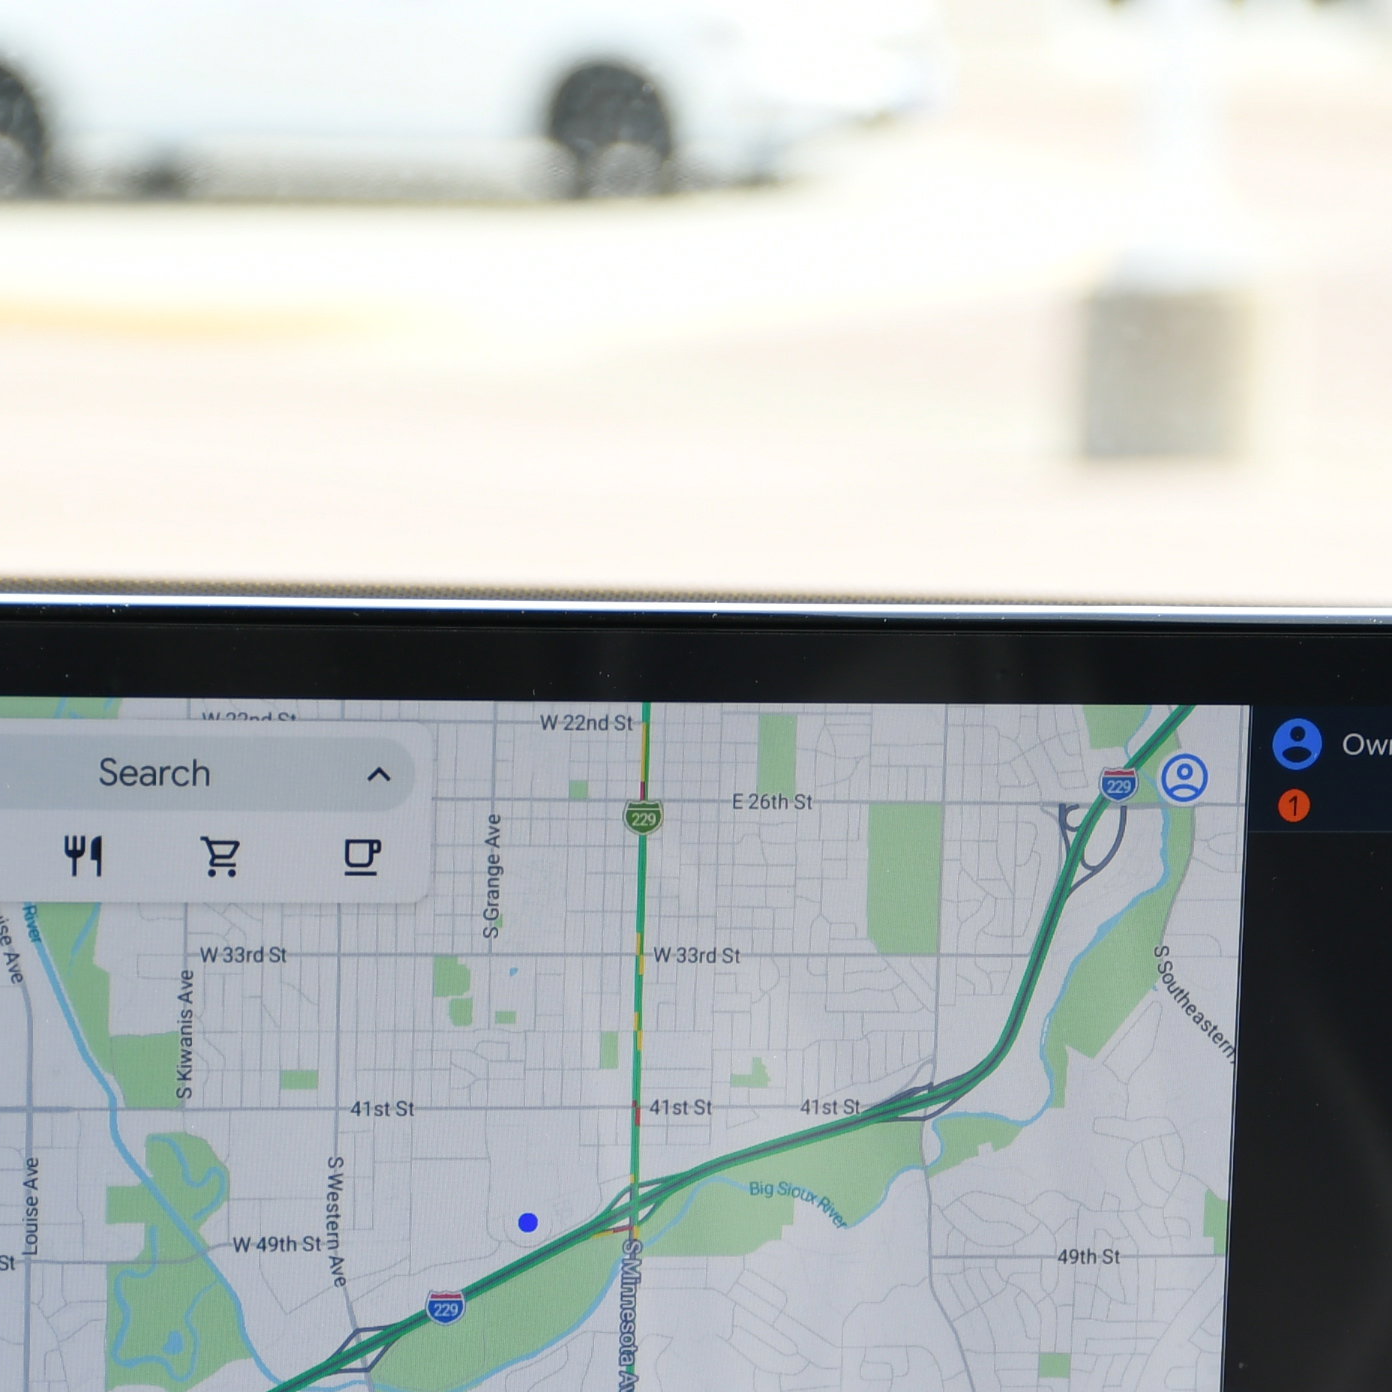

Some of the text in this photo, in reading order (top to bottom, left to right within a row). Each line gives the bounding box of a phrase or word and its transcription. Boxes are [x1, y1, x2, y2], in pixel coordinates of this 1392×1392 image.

[540, 714, 634, 731] W 22nd St
[99, 757, 211, 787] Search
[1107, 780, 1132, 794] 229
[732, 793, 812, 810] E 26th St
[1288, 795, 1299, 817] 1
[631, 812, 657, 826] 229
[483, 813, 504, 939] S Grange Ave
[200, 946, 287, 964] W 33rd St
[653, 946, 740, 964] W 33rd St
[3, 952, 24, 985] Ave
[1154, 945, 1236, 1064] S Southeastern
[176, 969, 194, 1099] S Kiwanis Ave
[350, 1100, 415, 1117] 41st St
[649, 1098, 712, 1115] 41st St
[800, 1098, 860, 1115] 41st St
[21, 1157, 39, 1255] Louise Ave
[749, 1181, 848, 1229] Big Sioux River
[326, 1156, 347, 1288] S Western Ave
[233, 1235, 321, 1253] W 49th St
[622, 1239, 643, 1255] S
[1057, 1248, 1120, 1264] 49th St
[434, 1303, 459, 1317] 229
[619, 1257, 642, 1366] Minnesota
